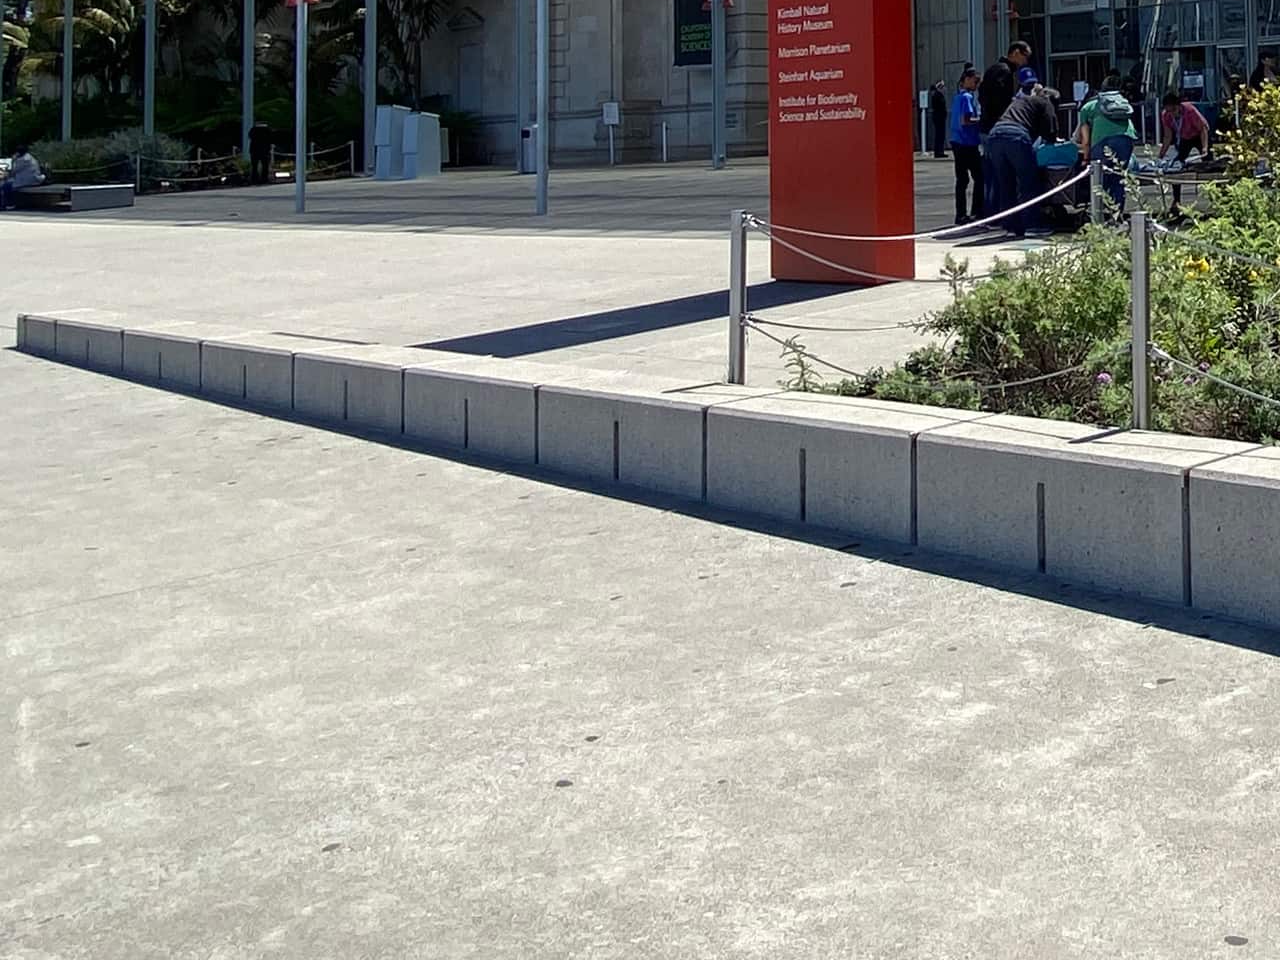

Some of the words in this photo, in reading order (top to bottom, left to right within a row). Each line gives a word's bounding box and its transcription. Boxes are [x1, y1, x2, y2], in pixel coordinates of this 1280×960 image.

[803, 3, 830, 17] Natural
[777, 22, 802, 34] History
[803, 20, 834, 31] Museum
[809, 44, 851, 56] Planetarium
[809, 69, 843, 81] Aquarium
[779, 96, 806, 107] Institute
[806, 94, 817, 105] for
[817, 93, 858, 105] Biodiversity
[779, 111, 804, 122] Science
[805, 109, 819, 121] and
[819, 107, 866, 120] Sustainability
